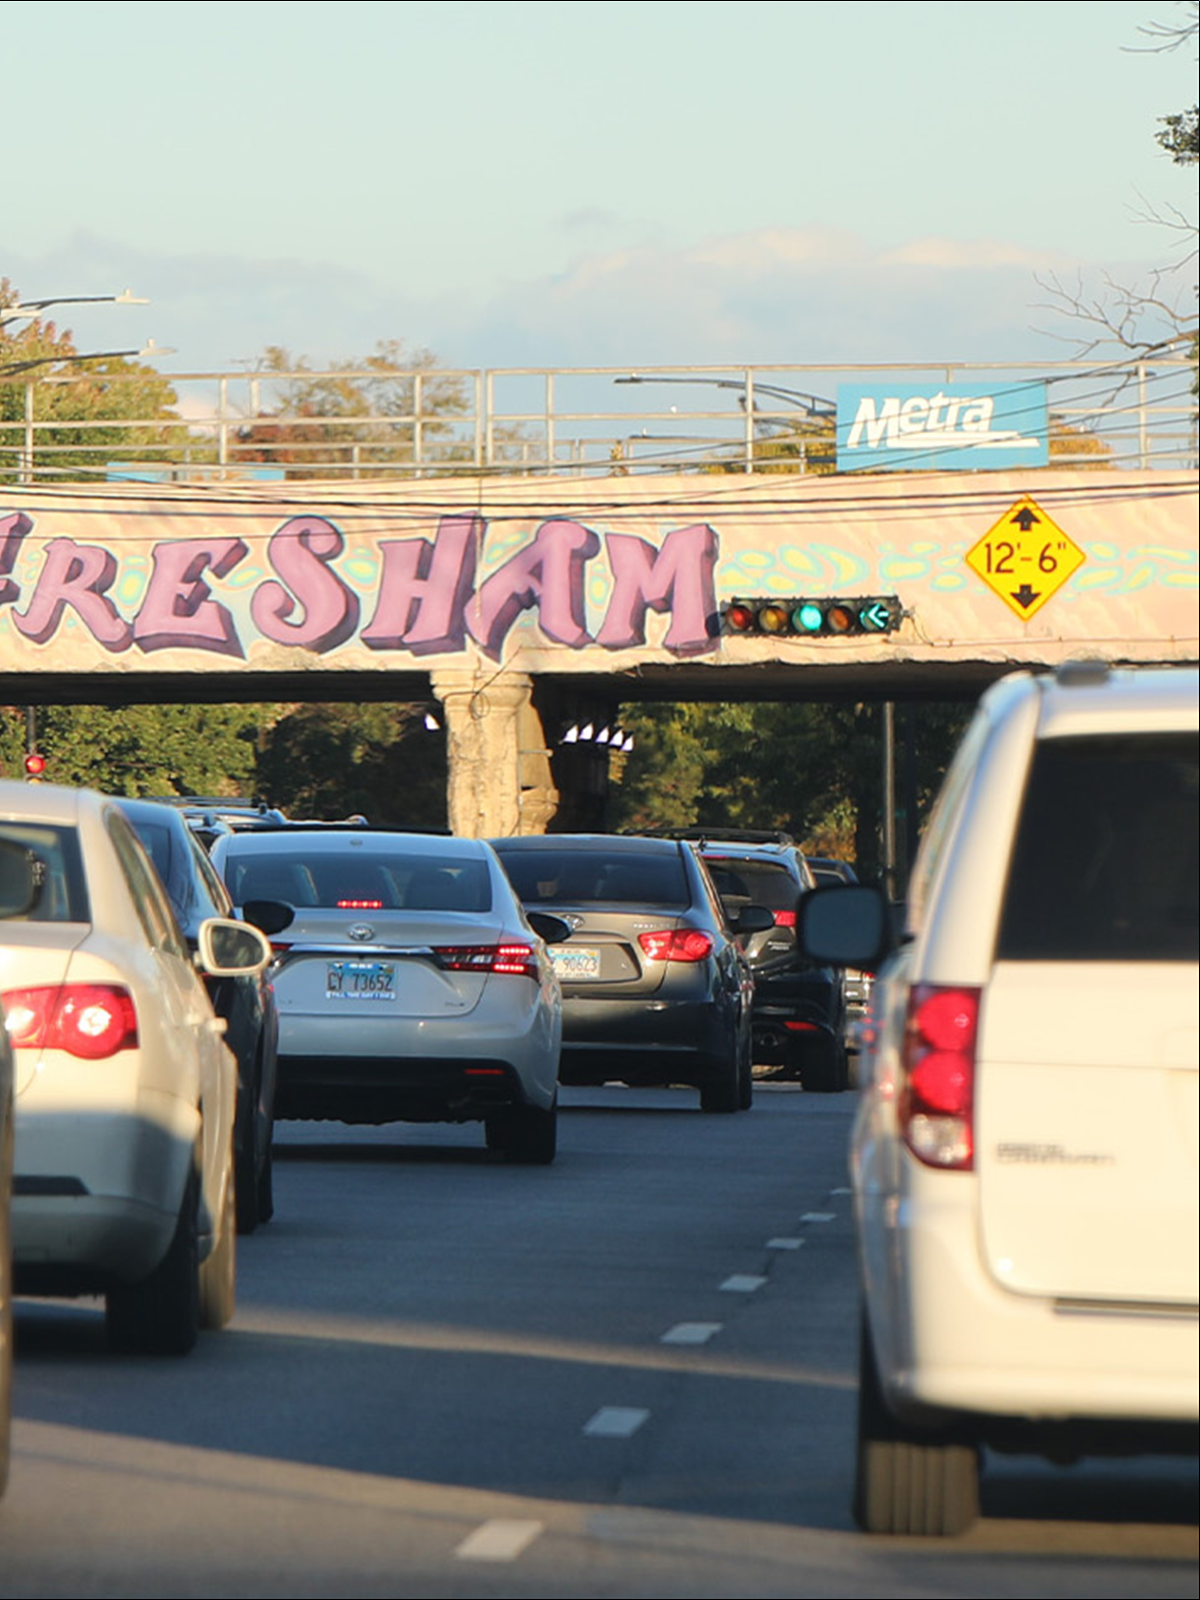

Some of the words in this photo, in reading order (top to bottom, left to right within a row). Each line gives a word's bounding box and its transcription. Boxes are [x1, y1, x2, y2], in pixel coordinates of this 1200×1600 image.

[847, 391, 994, 449] Metra
[985, 541, 1066, 574] 12'-6"
[353, 973, 393, 992] 73652
